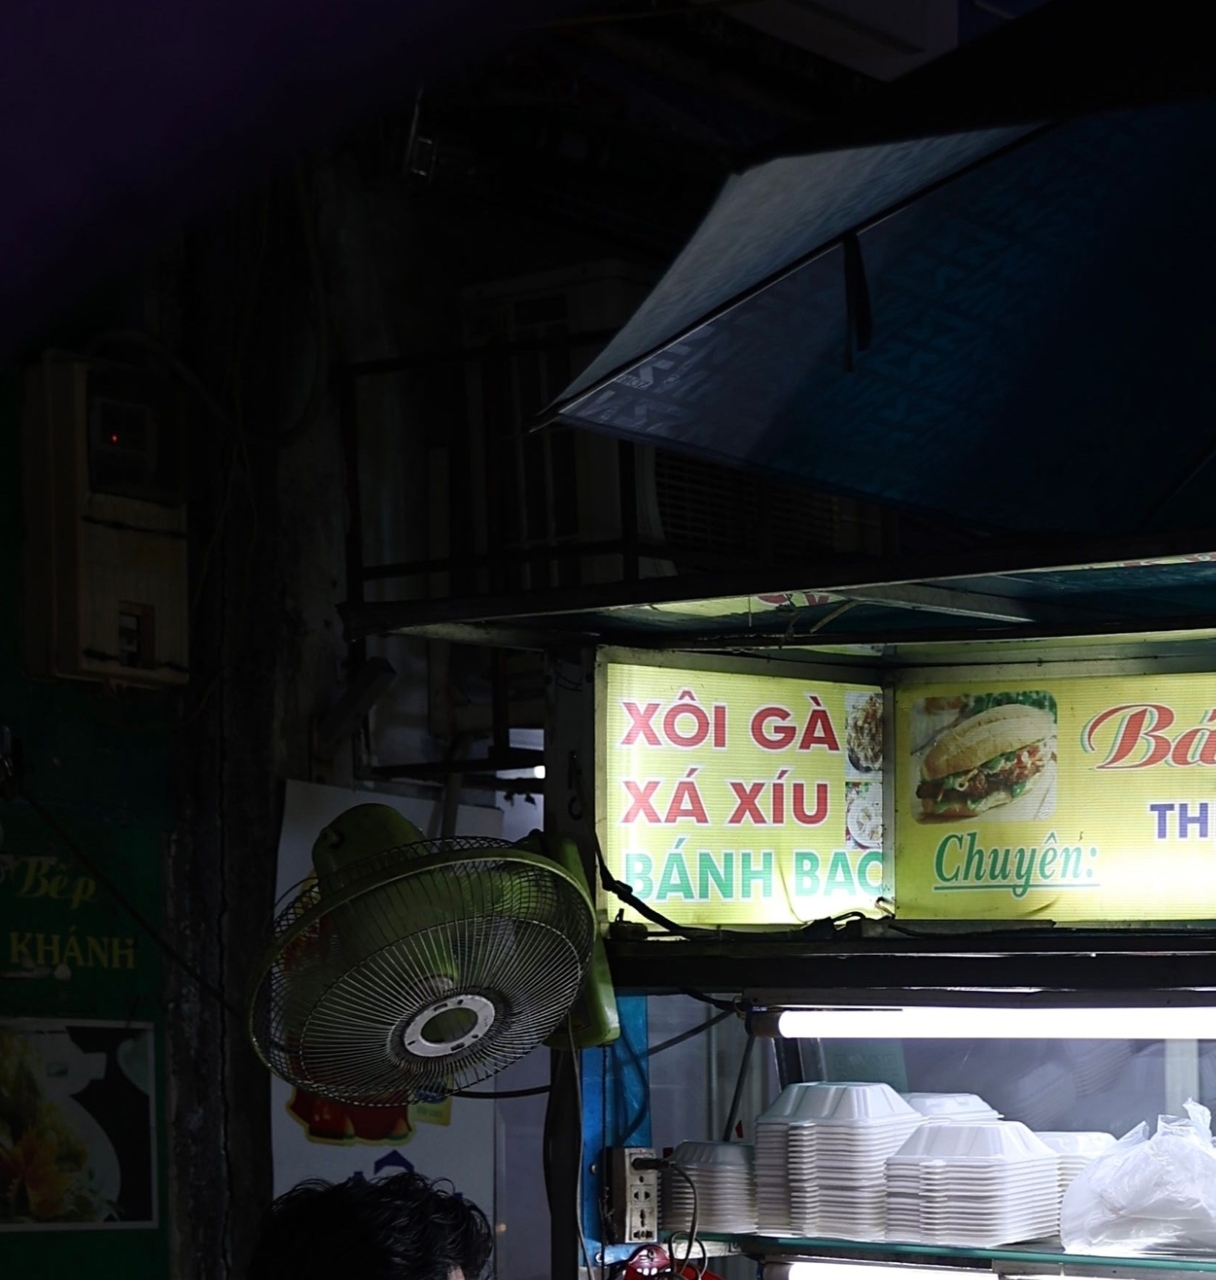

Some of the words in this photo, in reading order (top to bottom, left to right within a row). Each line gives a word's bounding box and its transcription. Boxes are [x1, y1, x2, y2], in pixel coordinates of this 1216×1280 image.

[619, 690, 727, 749] XÔI
[750, 695, 841, 751] GÀ
[620, 767, 710, 824] XÁ
[728, 769, 829, 825] XÍU
[624, 837, 774, 900] BÁNH
[933, 831, 1100, 898] Chuyên:
[9, 924, 136, 970] KHÁNH
